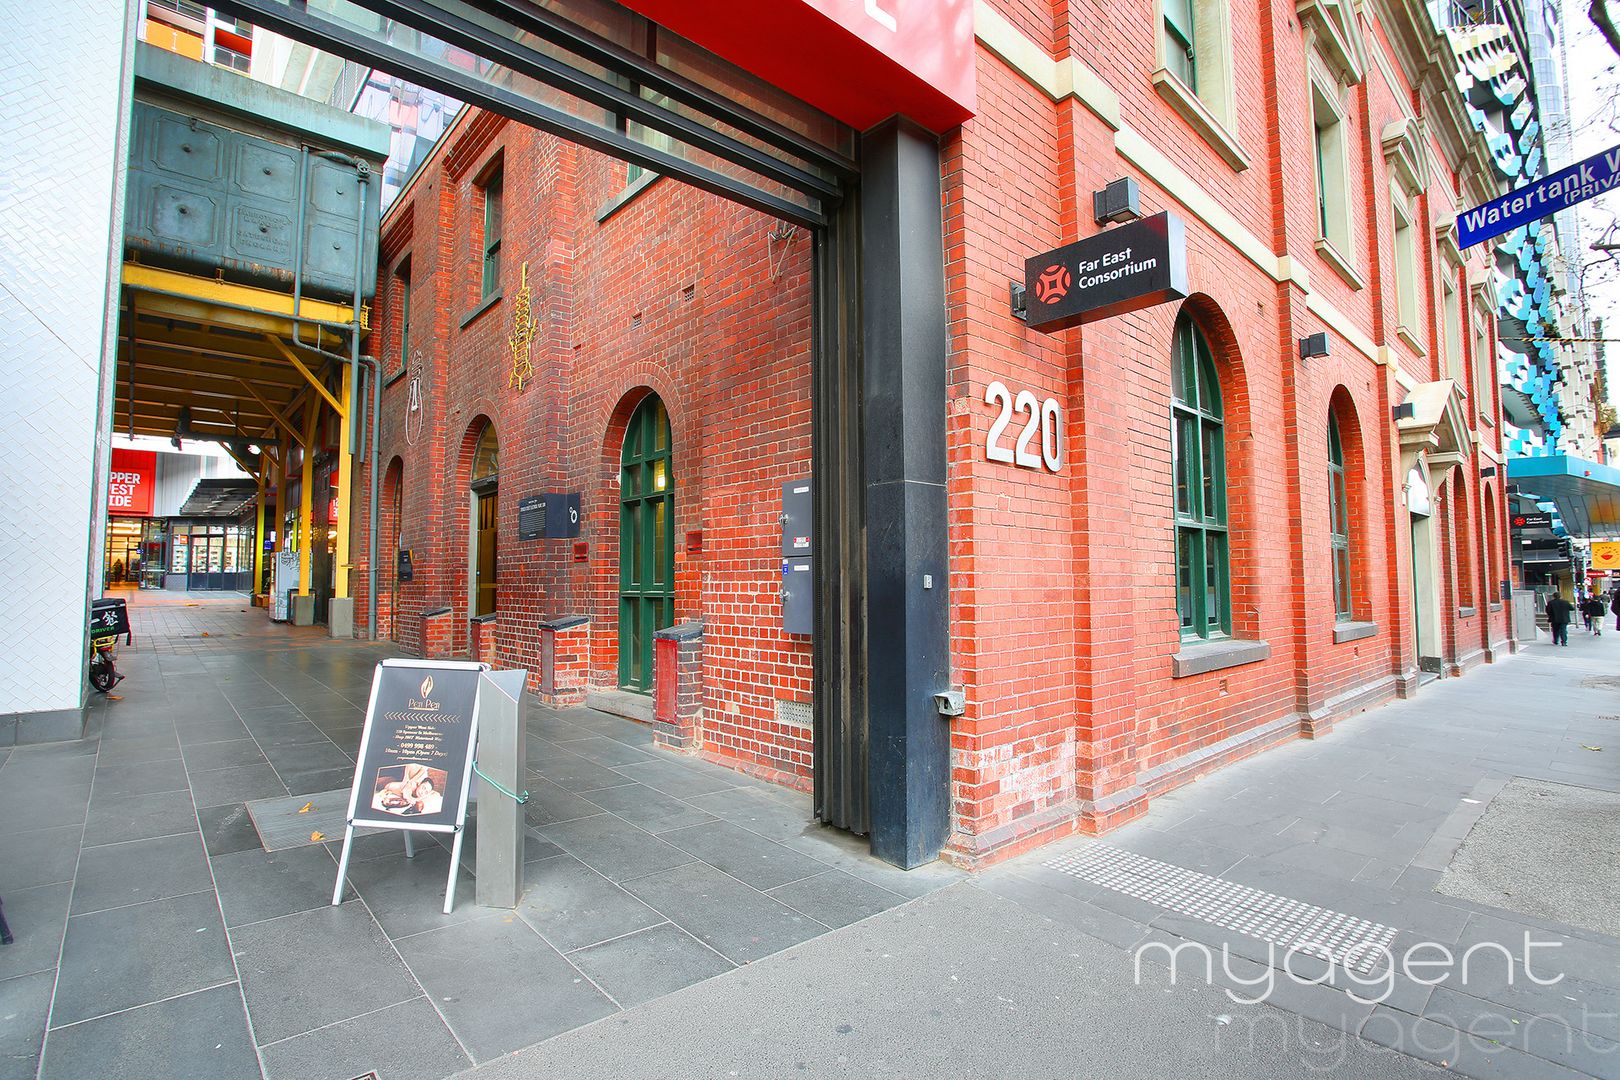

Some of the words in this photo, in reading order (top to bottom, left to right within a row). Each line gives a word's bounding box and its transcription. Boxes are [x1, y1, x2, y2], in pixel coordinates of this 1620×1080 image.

[1464, 163, 1596, 233] Watertank
[1078, 260, 1098, 274] Far
[1102, 247, 1132, 266] East
[1078, 256, 1157, 290] Consortium
[984, 380, 1065, 473] 220
[110, 471, 141, 485] PPER
[110, 483, 136, 496] EST
[108, 495, 133, 507] IDE
